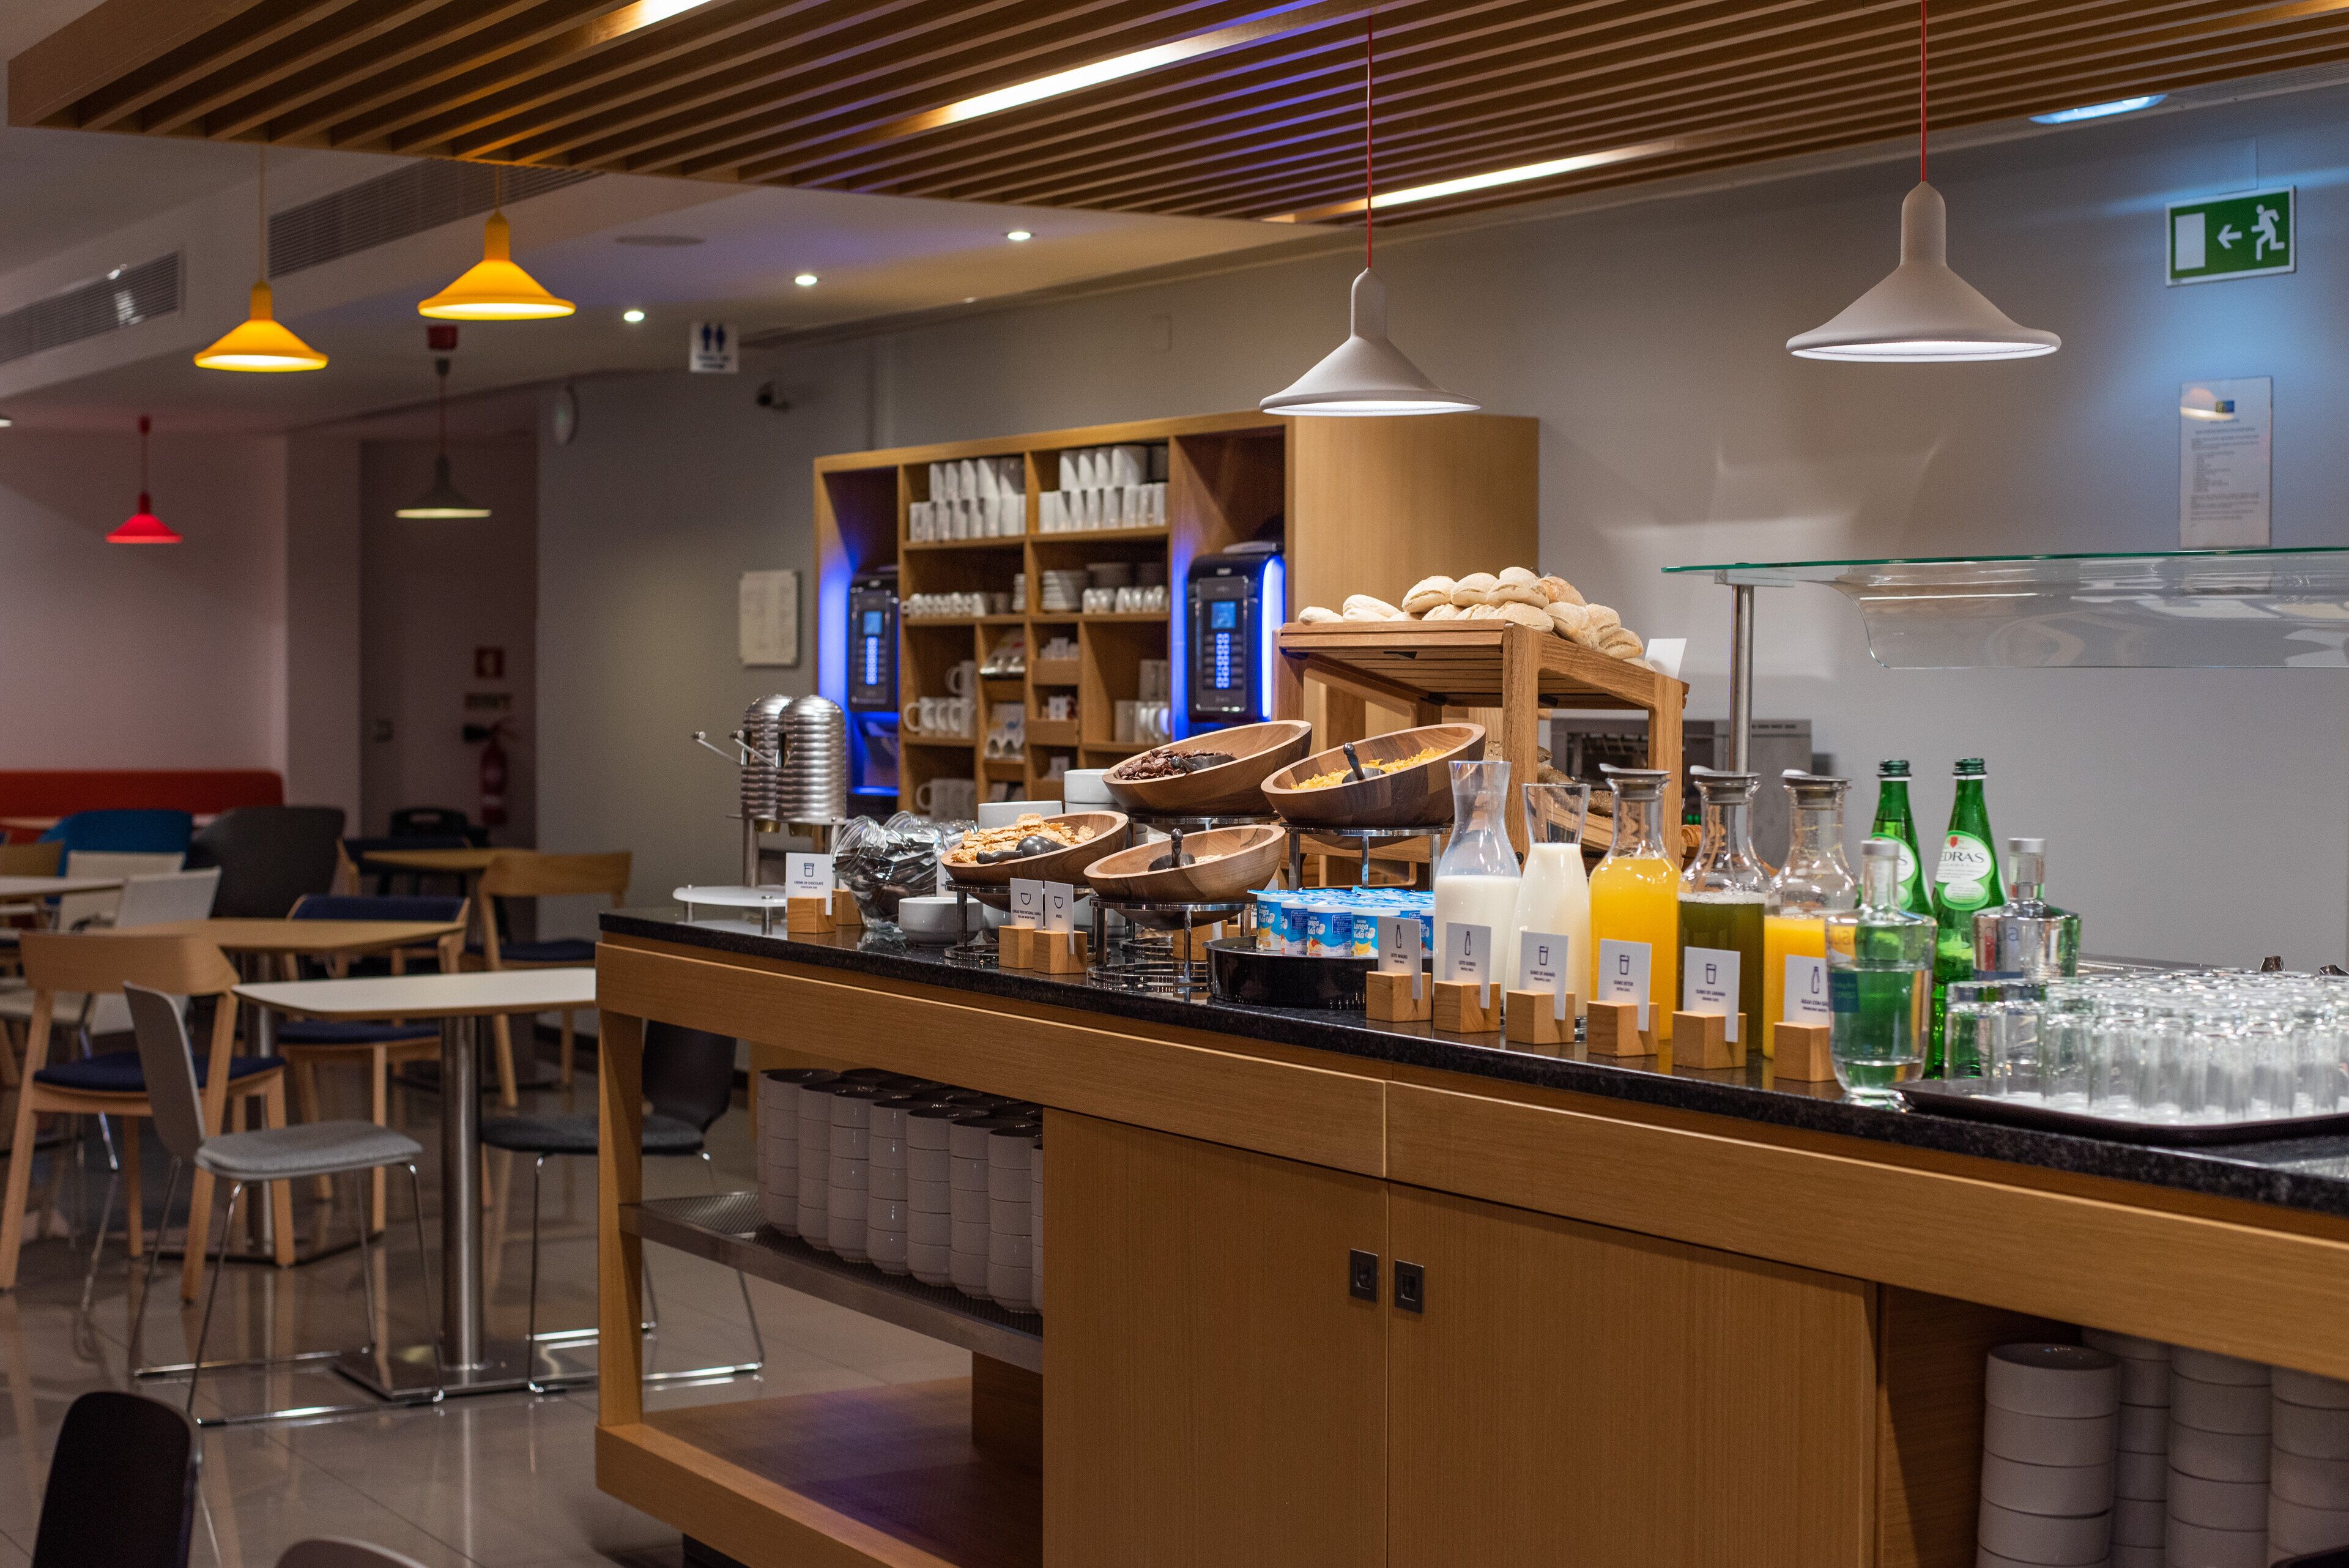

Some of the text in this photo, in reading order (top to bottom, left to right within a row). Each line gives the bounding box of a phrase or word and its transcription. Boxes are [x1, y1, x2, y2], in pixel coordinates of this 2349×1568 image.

[1939, 851, 1984, 863] EDRAS
[1354, 922, 1369, 932] Longa
[1354, 930, 1364, 938] Vida
